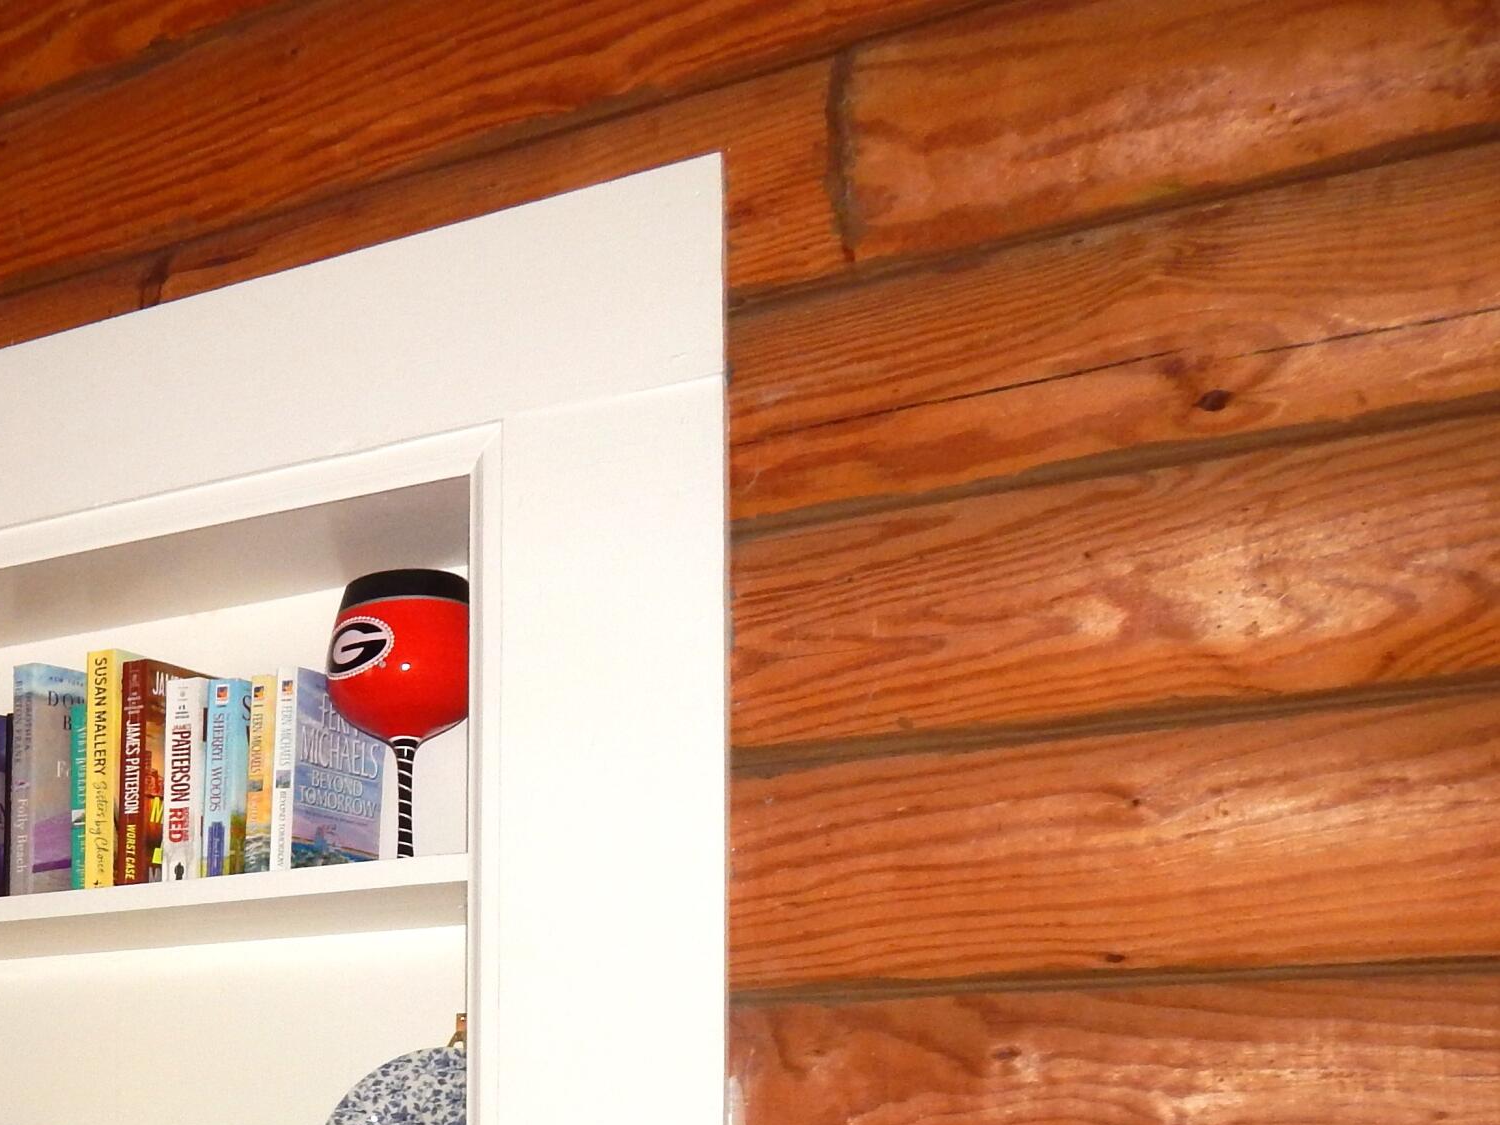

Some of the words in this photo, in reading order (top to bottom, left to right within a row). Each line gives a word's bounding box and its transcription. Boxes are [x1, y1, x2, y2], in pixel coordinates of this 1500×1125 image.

[94, 657, 108, 707] SUSAN
[253, 713, 264, 732] FERN
[281, 706, 293, 727] FERN
[93, 710, 107, 775] MALLERY
[124, 722, 141, 755] JAMES
[211, 713, 225, 763] SHERRYL
[279, 728, 292, 770] MICHAELS
[300, 725, 380, 779] MICHAELS
[171, 730, 192, 802] PATTERSON
[251, 735, 264, 779] MICHAELS
[124, 756, 141, 815] PATTERSON
[209, 767, 224, 812] WOODS
[300, 785, 378, 818] TOMORROW
[310, 769, 363, 797] BEYOND
[15, 798, 28, 830] Folly
[89, 820, 106, 836] by
[168, 808, 183, 843] RED
[15, 834, 28, 874] Beach
[126, 824, 137, 853] WORST
[124, 856, 135, 880] CASE
